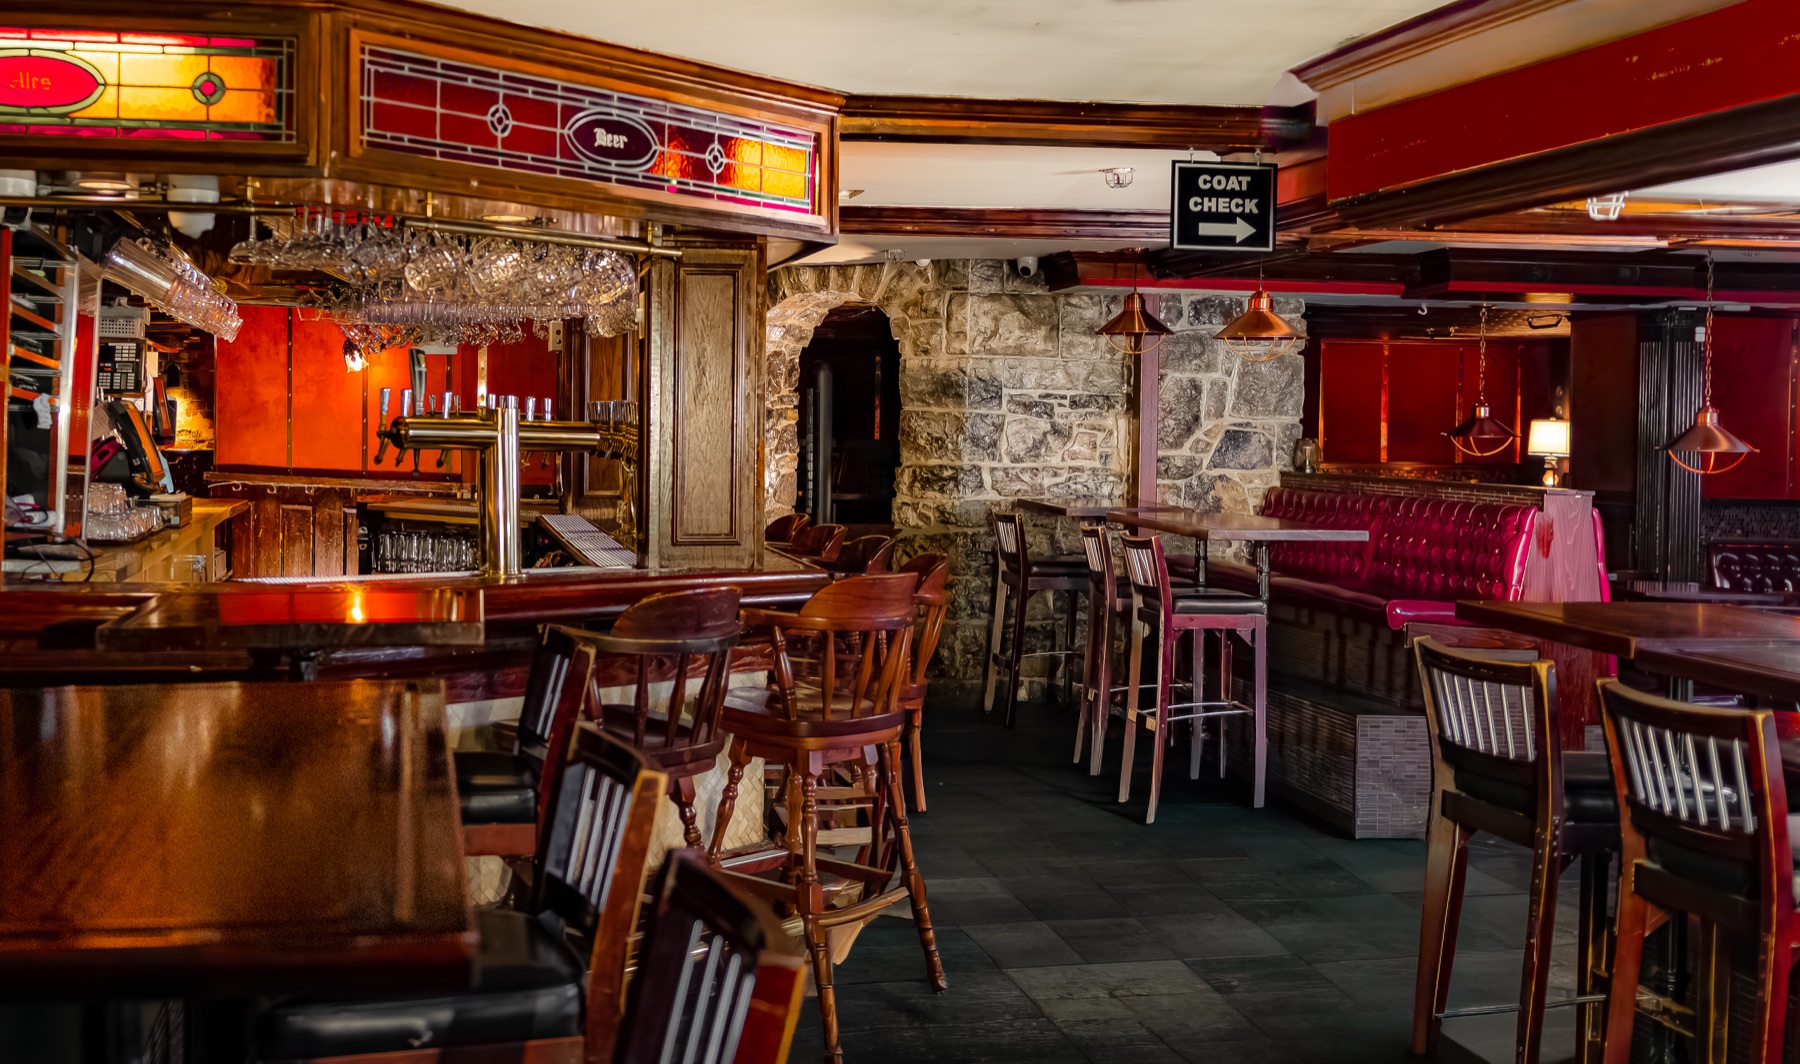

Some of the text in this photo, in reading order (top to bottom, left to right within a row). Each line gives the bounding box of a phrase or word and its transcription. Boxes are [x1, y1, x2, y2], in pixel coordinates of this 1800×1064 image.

[9, 71, 52, 91] Ales
[593, 127, 629, 149] Beer
[1198, 174, 1251, 191] COAT
[1188, 196, 1260, 214] CHECK
